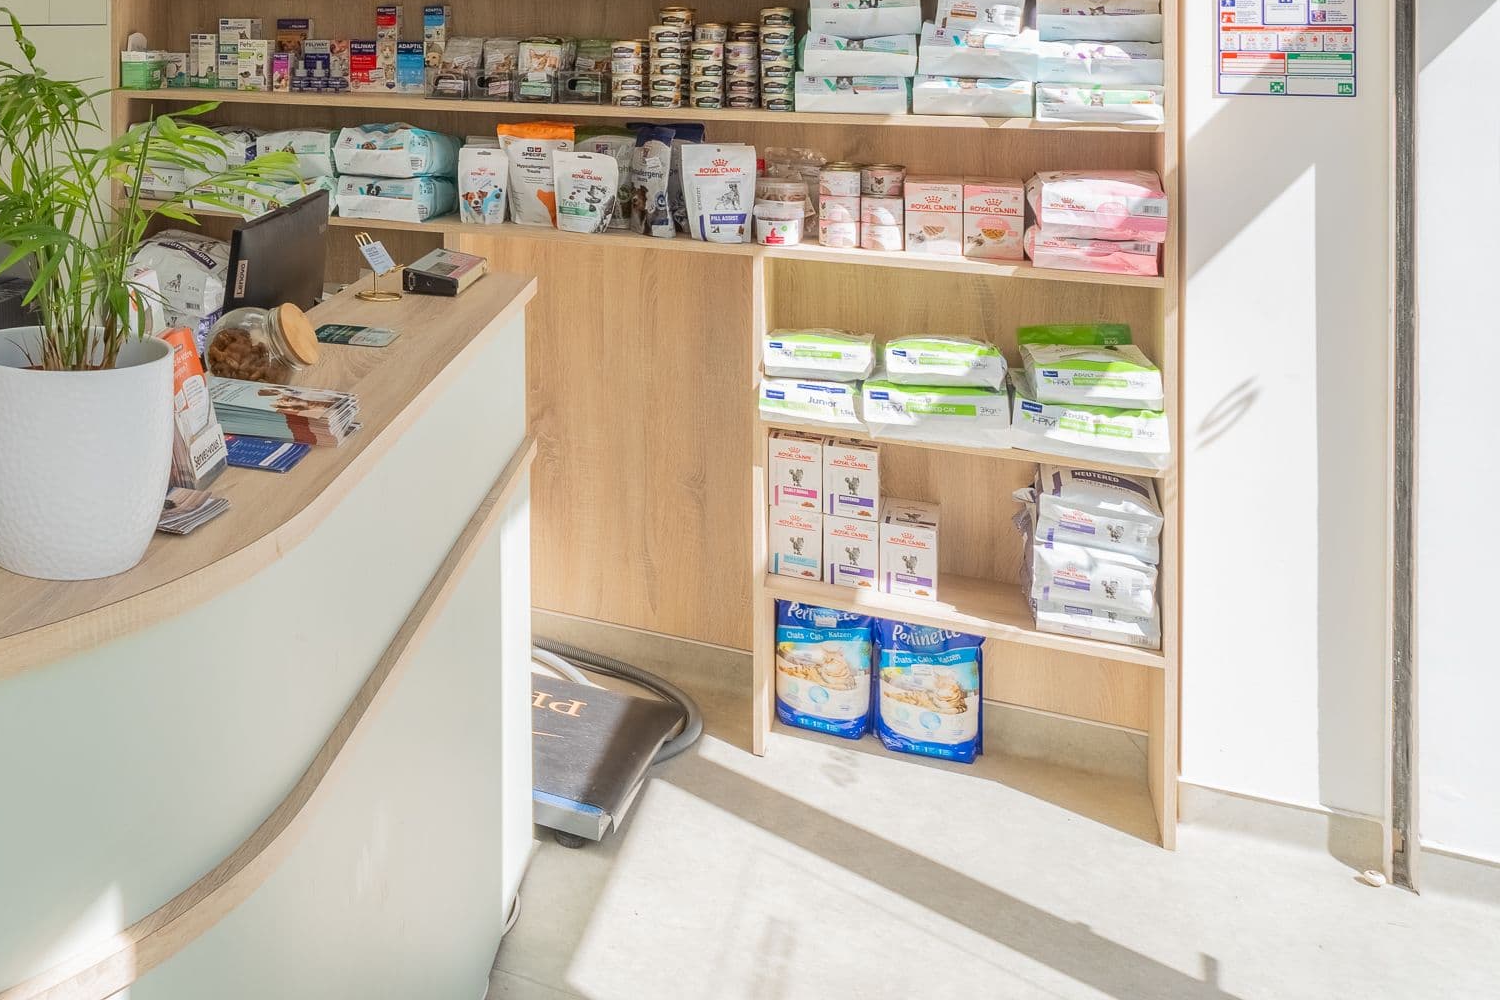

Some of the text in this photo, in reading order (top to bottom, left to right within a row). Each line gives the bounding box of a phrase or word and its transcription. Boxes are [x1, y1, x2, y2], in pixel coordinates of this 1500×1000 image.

[934, 203, 957, 211] CANIN
[970, 205, 1018, 214] ROYAL CANIN
[195, 249, 215, 266] ADULT
[237, 262, 247, 298] Lenovo
[808, 395, 837, 408] Junior
[1032, 415, 1056, 427] HPM
[1062, 411, 1090, 422] ADULT
[193, 438, 220, 468] Servez-vous
[1074, 470, 1120, 483] NEUTERED
[907, 539, 925, 547] CANIN
[786, 631, 805, 639] Chats
[893, 655, 913, 663] Chats
[939, 654, 962, 663] Katzen
